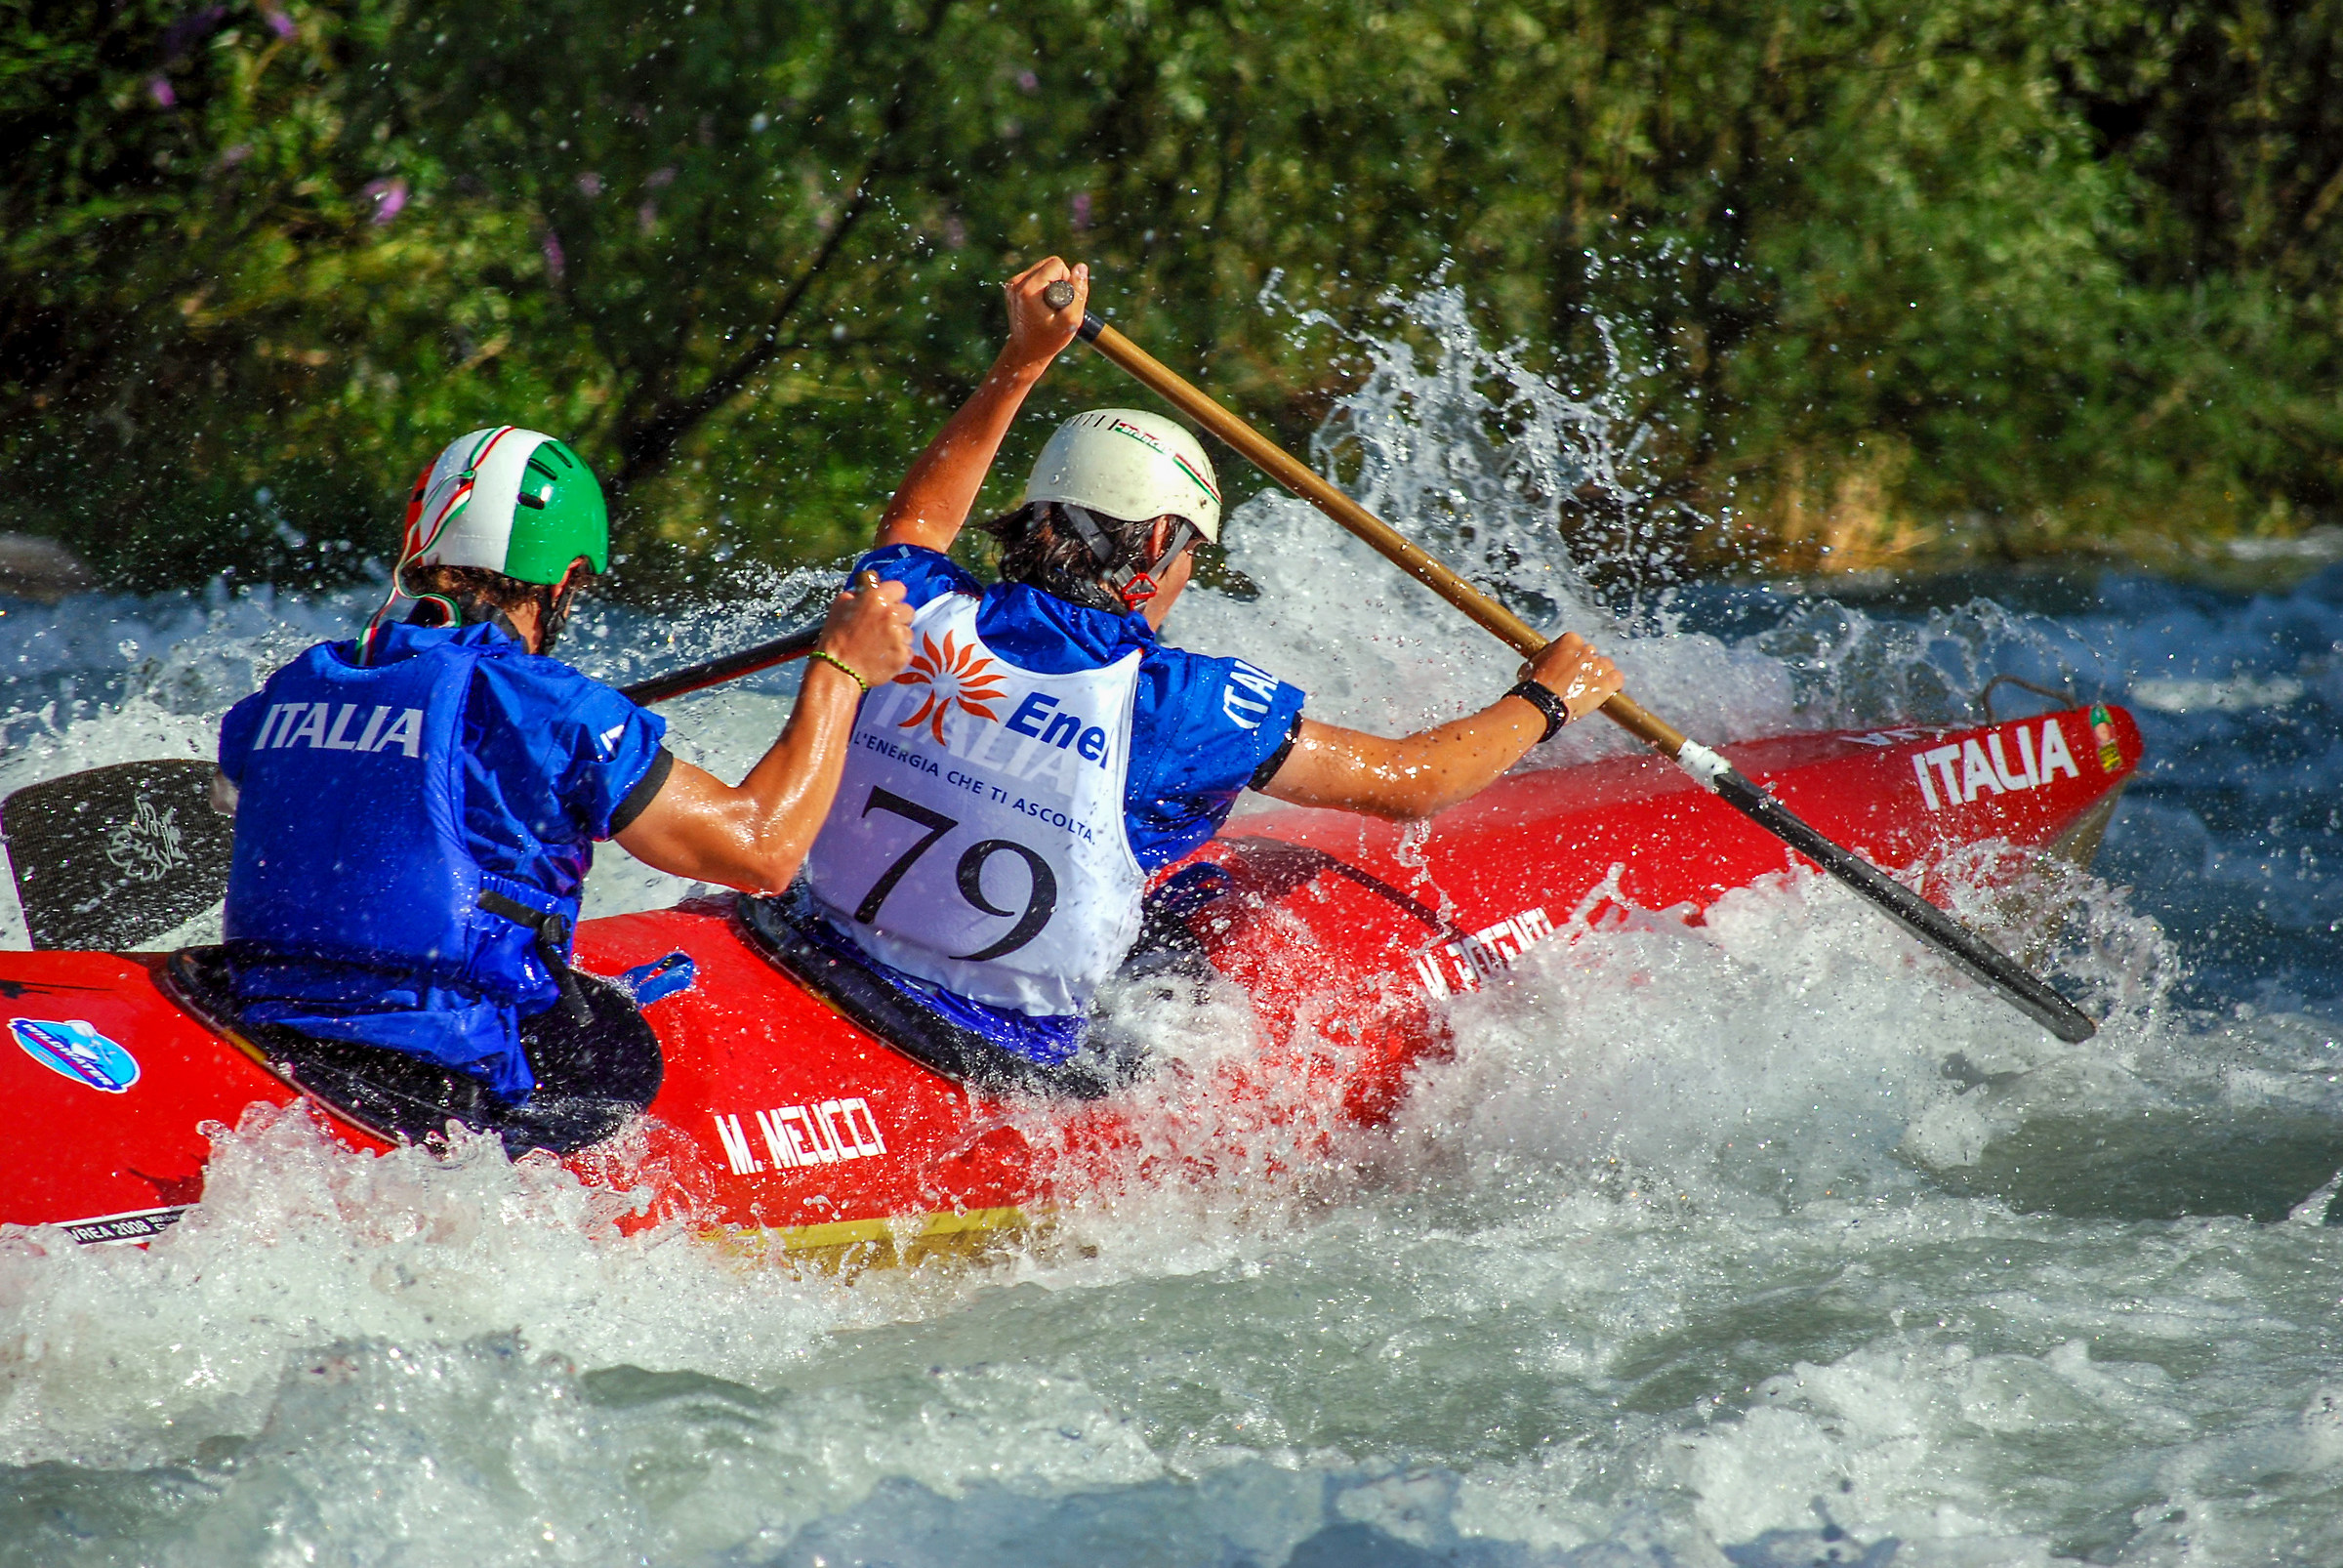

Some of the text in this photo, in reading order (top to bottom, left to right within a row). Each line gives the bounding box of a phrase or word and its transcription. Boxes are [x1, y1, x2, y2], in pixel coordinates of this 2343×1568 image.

[253, 702, 425, 759] ITALIA
[1006, 691, 1115, 770] Enel
[1911, 719, 2080, 811] ITALIA
[853, 730, 1096, 846] L'ENERGIA CHE TI ASCOLTA.
[852, 784, 1058, 963] 79
[21, 1023, 115, 1087] WILDWATER
[714, 1096, 887, 1176] M. MEUCCI
[111, 1219, 151, 1237] 2008
